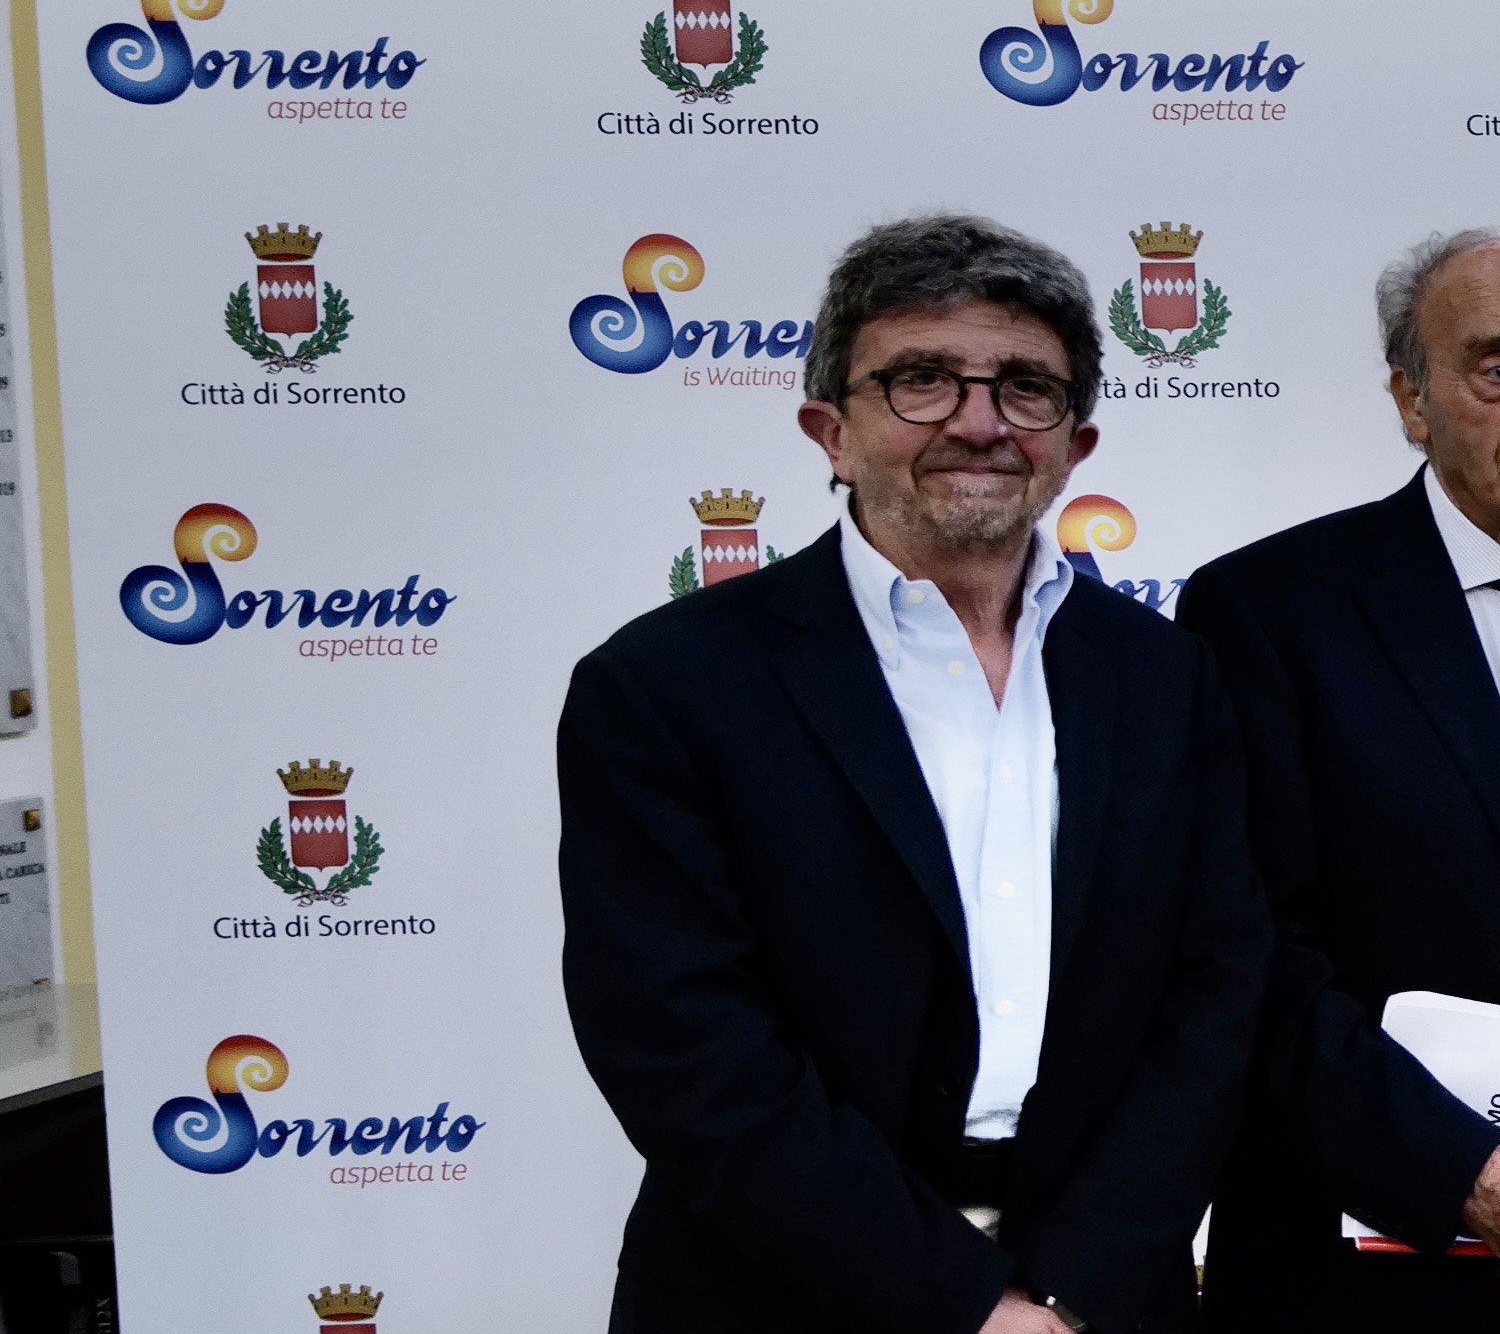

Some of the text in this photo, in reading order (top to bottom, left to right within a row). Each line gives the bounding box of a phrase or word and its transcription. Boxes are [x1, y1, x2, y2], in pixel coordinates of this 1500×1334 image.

[268, 98, 407, 124] aspetta te
[598, 112, 818, 134] Città di Sorrento
[1153, 100, 1286, 125] aspetta te
[684, 366, 796, 390] is Waiting
[1136, 377, 1158, 398] di
[1168, 377, 1279, 398] Sorrento
[181, 382, 405, 405] Città di Sorrento
[119, 503, 456, 645] Sorrento
[299, 635, 437, 662] aspetta te
[214, 915, 435, 939] Città di Sorrento
[153, 1034, 486, 1175] Sorrento
[330, 1161, 467, 1189] aspetta te
